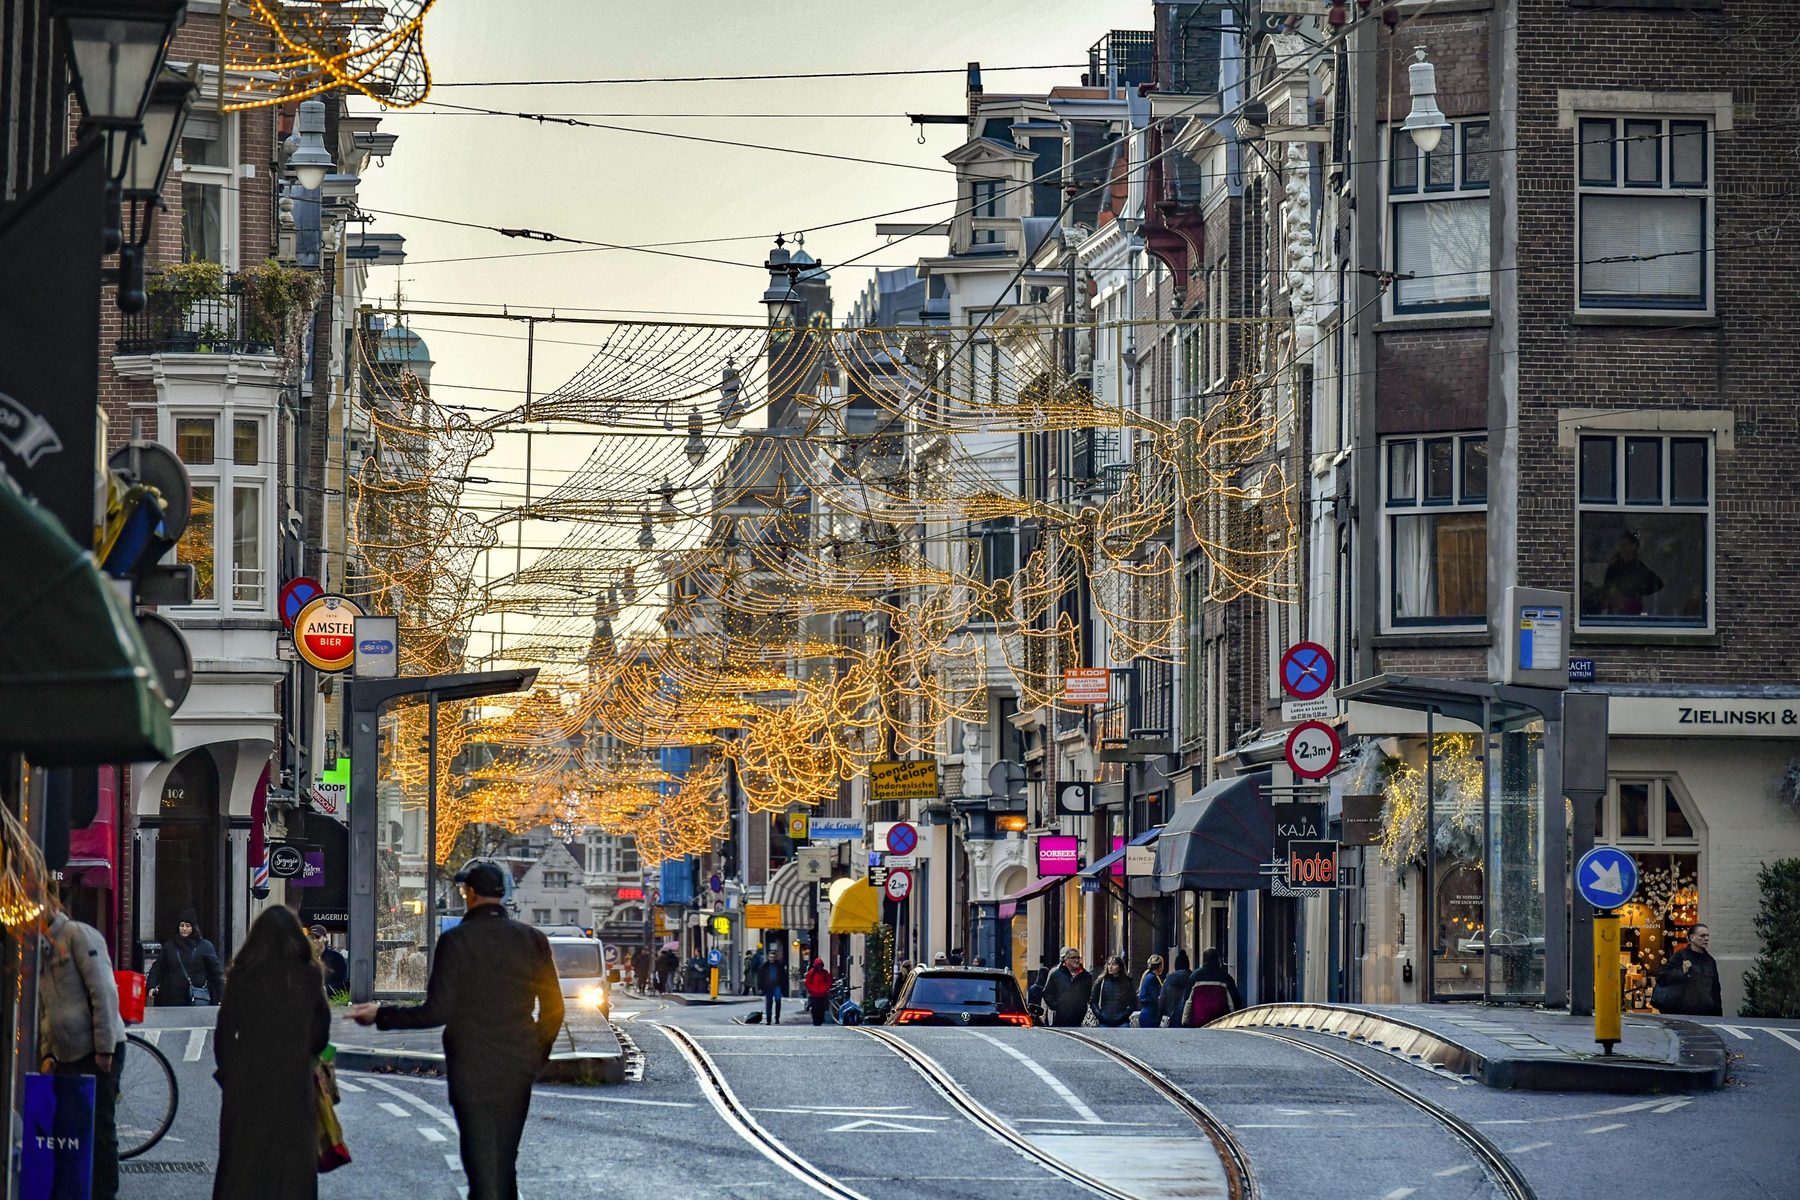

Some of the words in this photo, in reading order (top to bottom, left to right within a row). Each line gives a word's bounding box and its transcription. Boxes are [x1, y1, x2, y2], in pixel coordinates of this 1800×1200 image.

[1095, 375, 1105, 397] koop
[307, 622, 353, 634] AMSTEL
[320, 638, 342, 646] BIER
[1679, 708, 1776, 724] ZIELINSKI
[1781, 709, 1798, 725] &
[1299, 741, 1326, 759] 2,3m
[871, 762, 915, 781] Soenda
[893, 765, 935, 783] Kelapa
[875, 781, 934, 790] Indonesische
[167, 789, 184, 798] 102
[874, 789, 935, 797] Specialiteiten
[824, 821, 834, 829] de
[1277, 824, 1318, 836] KAJA
[1039, 850, 1076, 858] OORBEEK
[1291, 851, 1337, 882] hotel
[35, 1136, 80, 1150] TEYM
